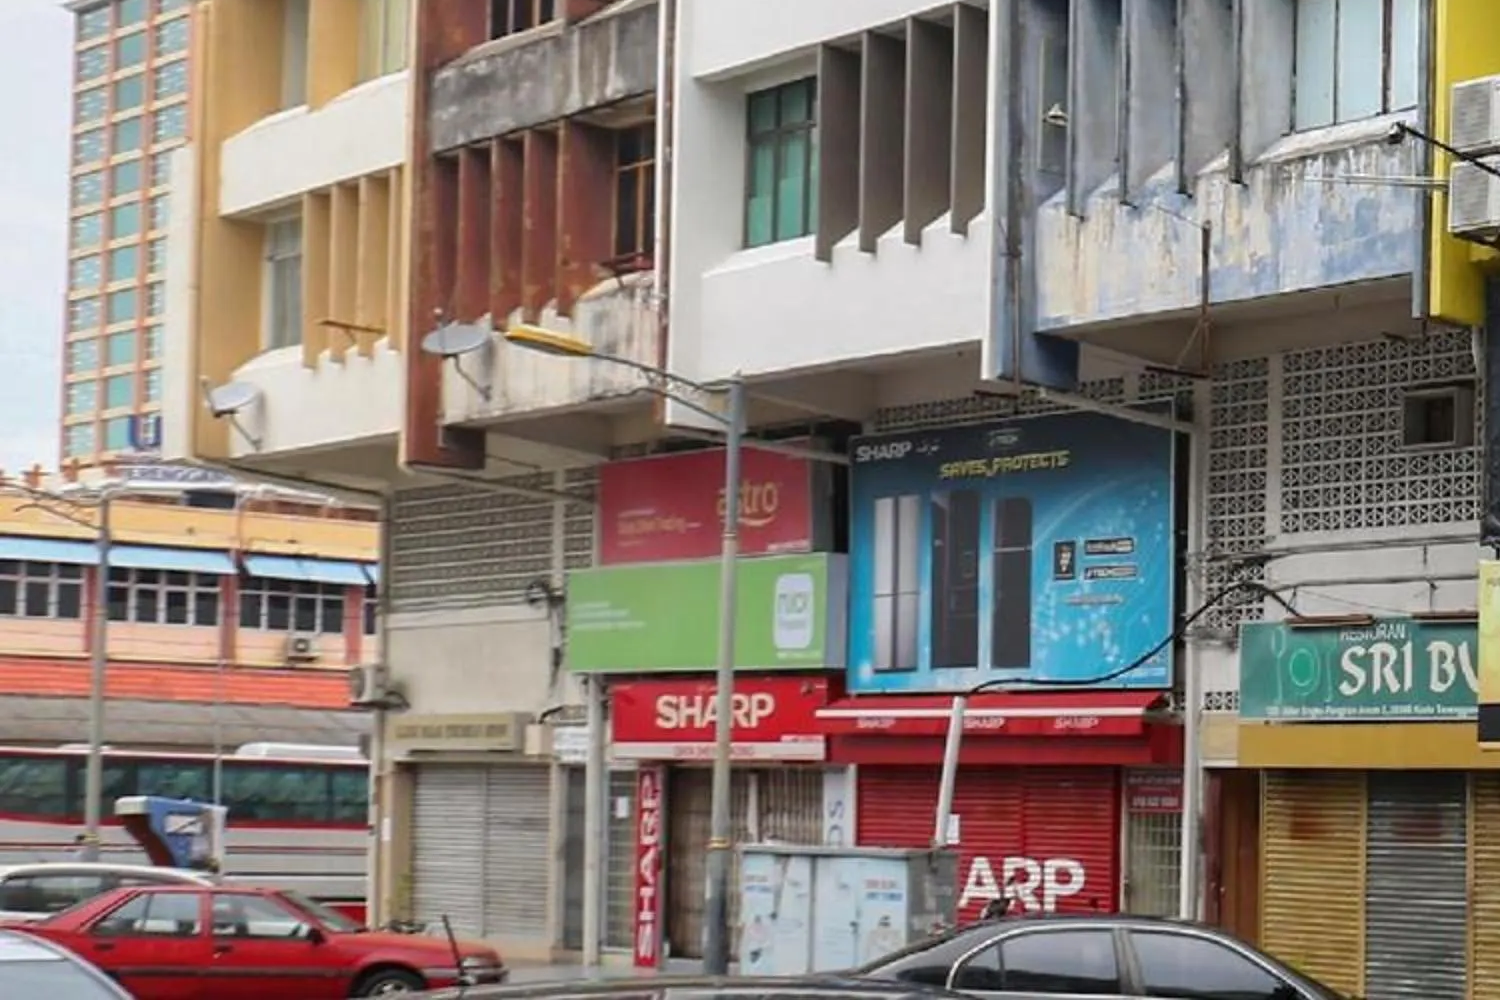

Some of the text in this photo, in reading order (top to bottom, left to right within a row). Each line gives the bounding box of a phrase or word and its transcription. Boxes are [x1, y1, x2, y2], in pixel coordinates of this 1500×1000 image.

[856, 441, 912, 462] SHARP
[717, 481, 779, 517] atro
[1339, 641, 1412, 697] SRI
[655, 692, 775, 729] SHARP
[957, 855, 1086, 914] ARP
